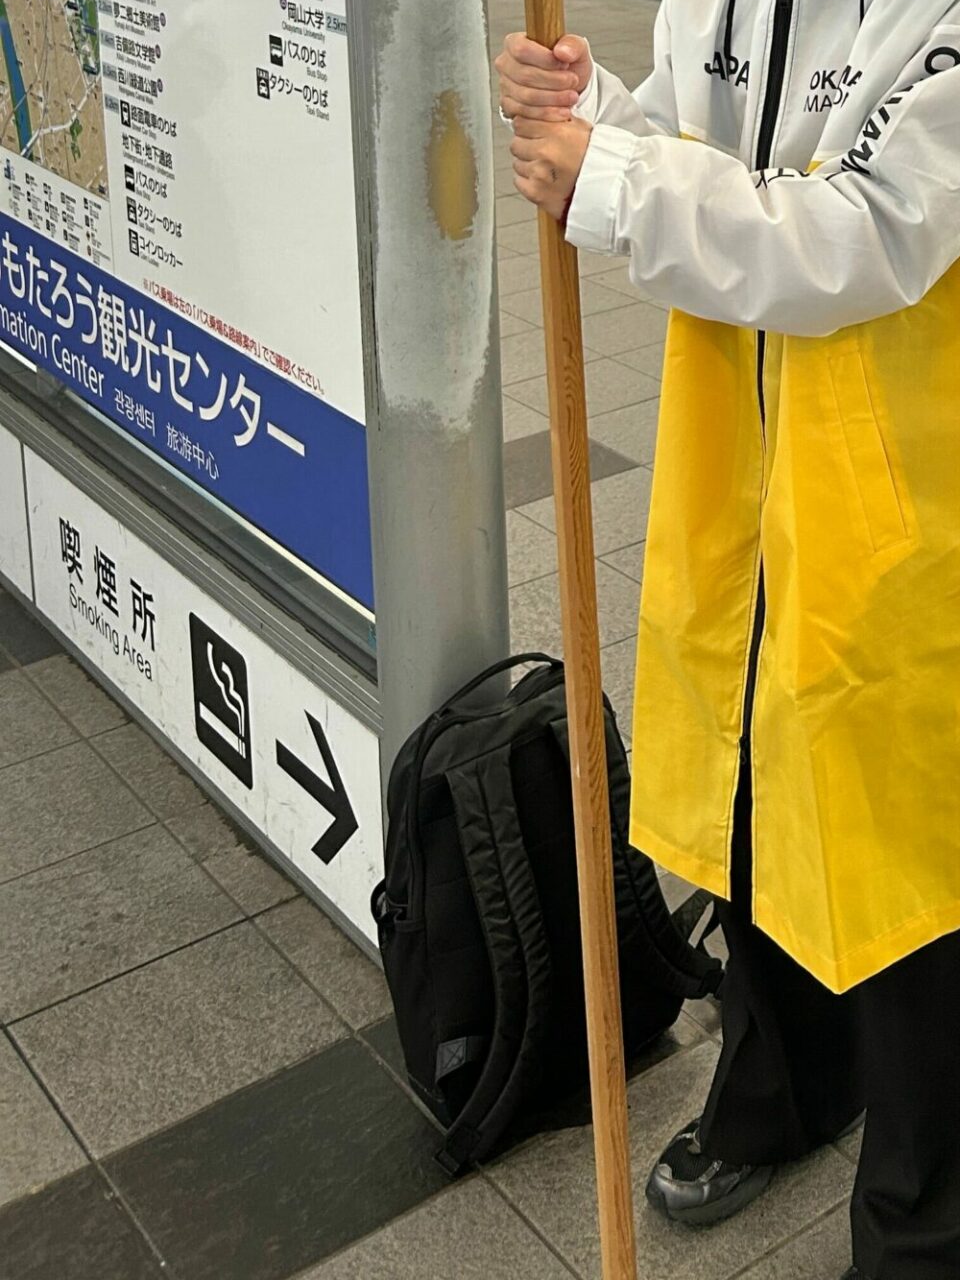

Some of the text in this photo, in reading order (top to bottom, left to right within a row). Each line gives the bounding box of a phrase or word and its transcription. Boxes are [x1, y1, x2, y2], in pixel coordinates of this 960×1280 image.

[287, 1, 325, 30] 岡山大学
[283, 39, 328, 69] バスのりば
[270, 73, 329, 109] タクシーのりば
[136, 170, 168, 199] バスのりば
[137, 202, 183, 238] タクシーのりば
[139, 235, 184, 268] コインロッカー
[52, 333, 105, 398] Center
[114, 386, 220, 481] 관광센터 旅游中心
[59, 517, 157, 652] 喫煙所
[68, 583, 153, 682] Smoking Area
